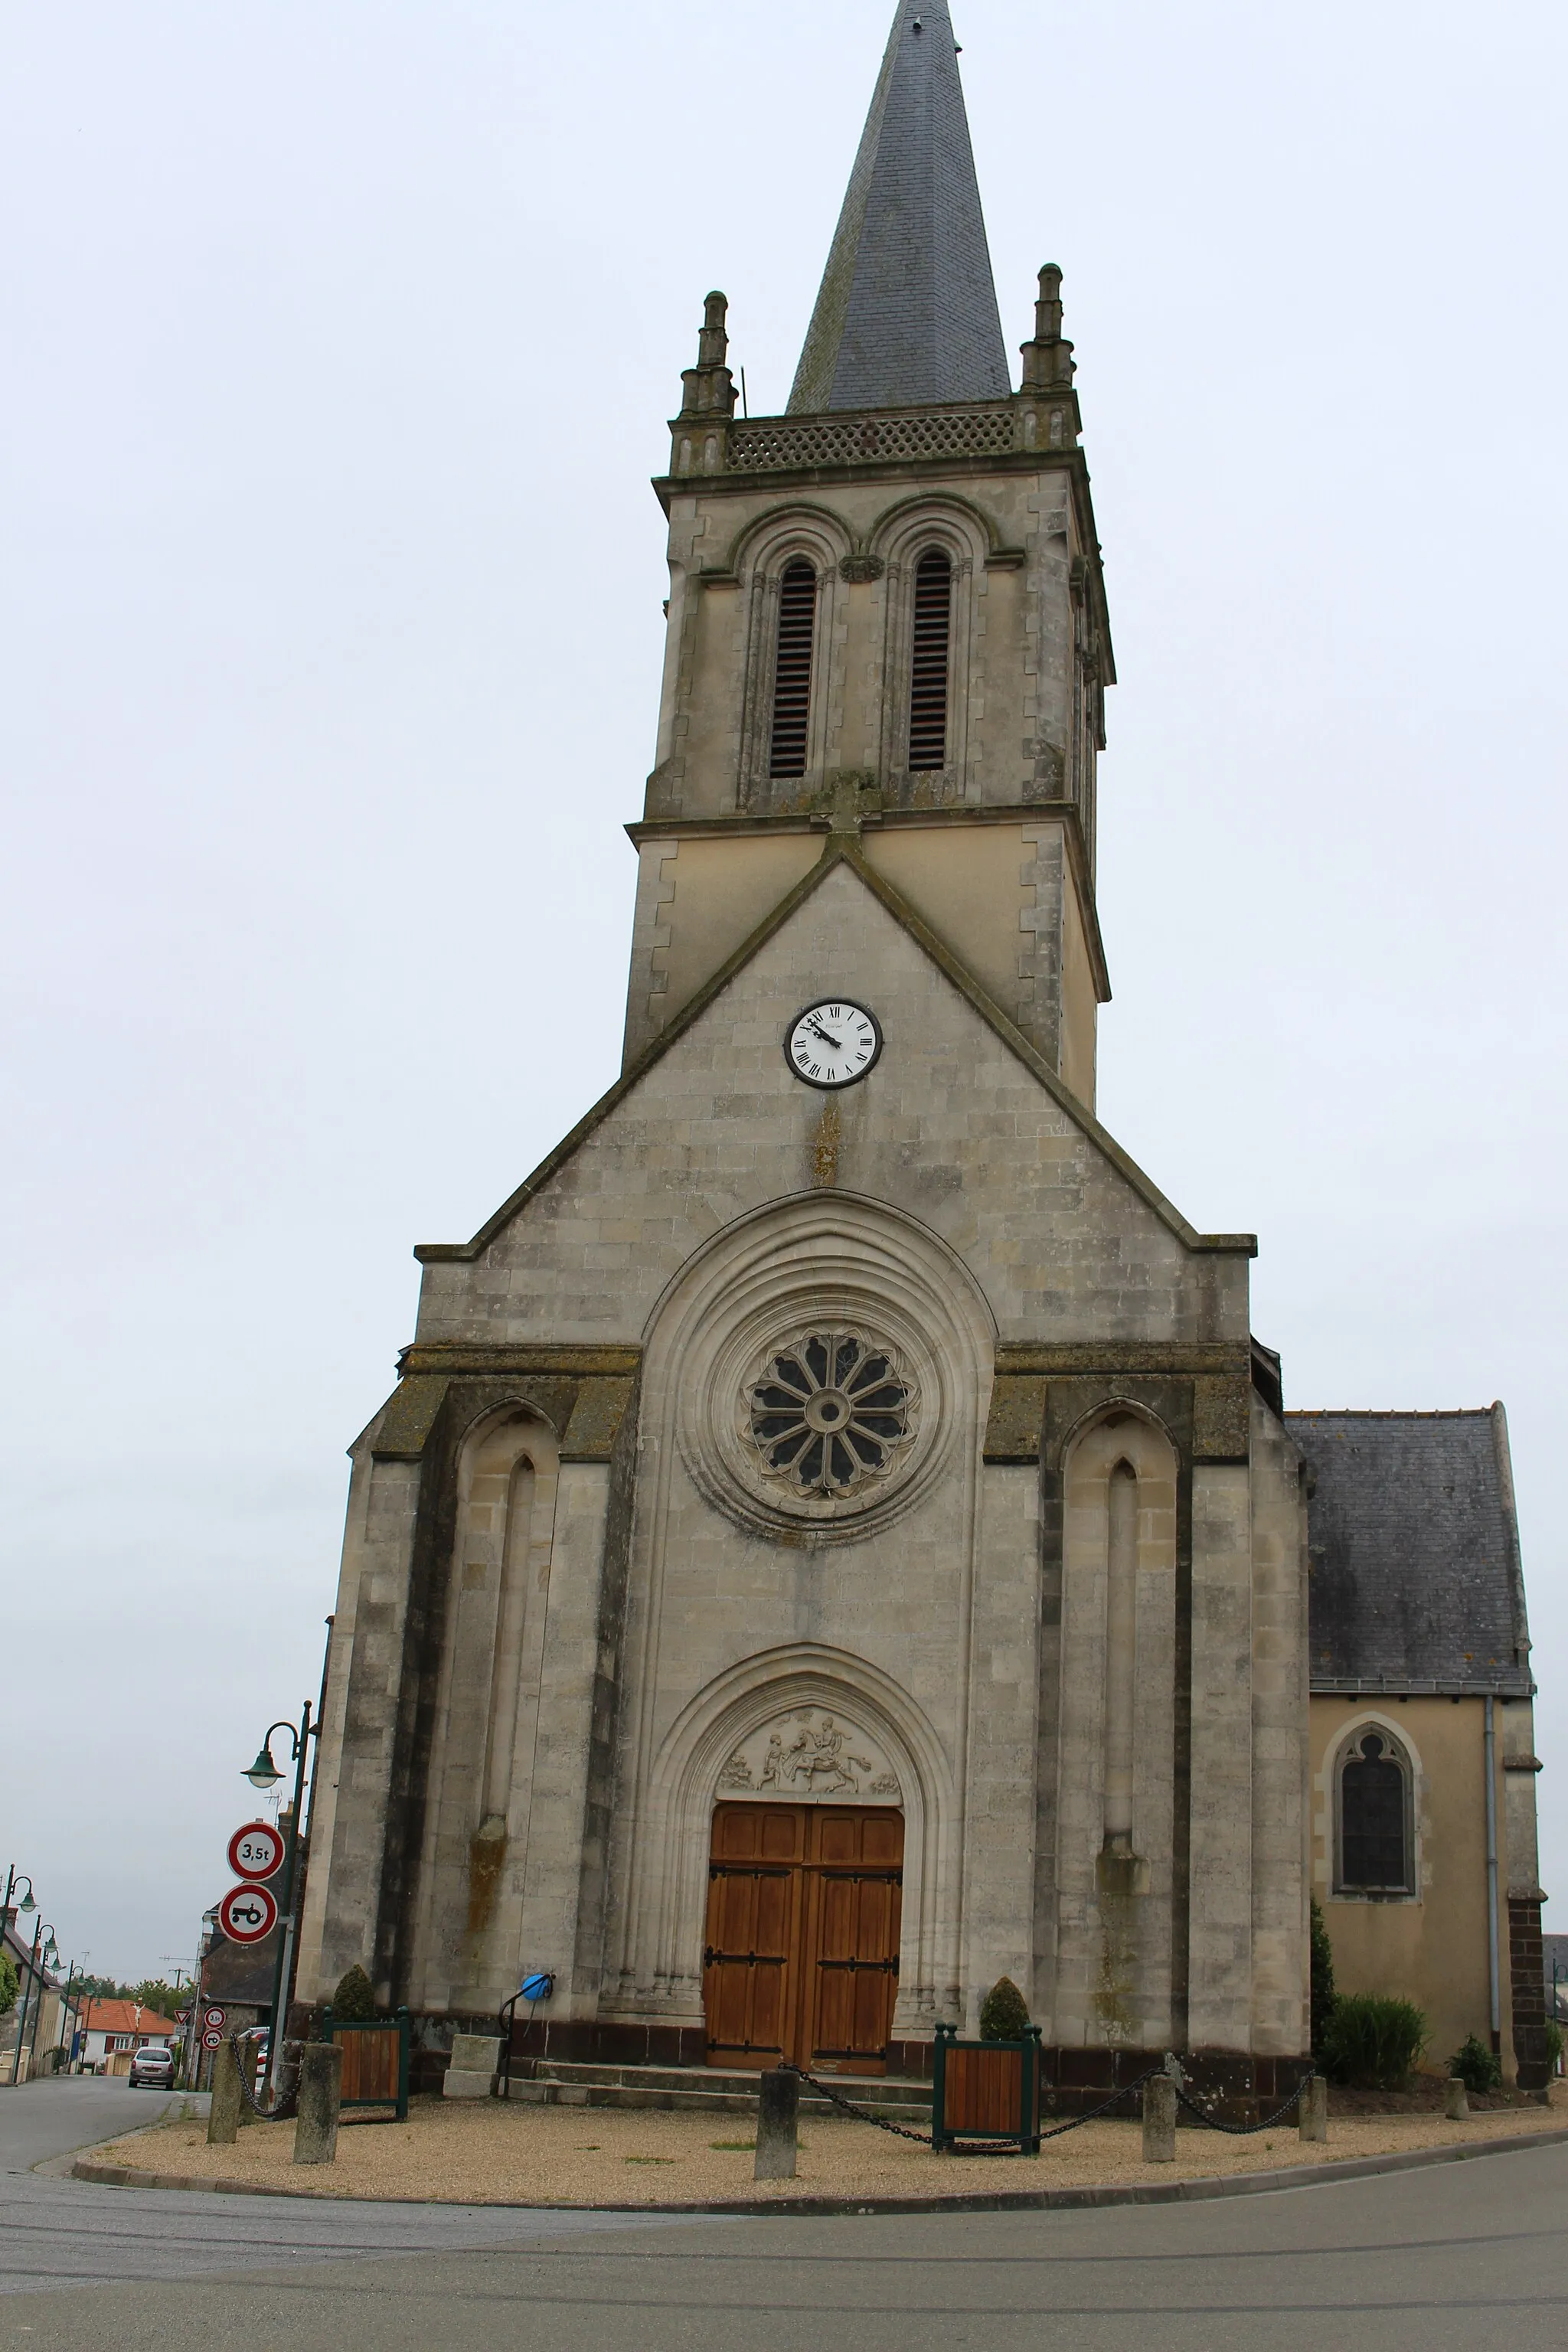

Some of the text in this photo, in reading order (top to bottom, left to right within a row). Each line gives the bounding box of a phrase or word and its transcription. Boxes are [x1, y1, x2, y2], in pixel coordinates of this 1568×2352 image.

[812, 1011, 824, 1024] XI
[829, 1006, 840, 1018] XII
[847, 1011, 855, 1021] I
[799, 1024, 812, 1033] X
[856, 1022, 869, 1031] II
[860, 1037, 873, 1046] III
[796, 1051, 812, 1068] VIII
[808, 1063, 822, 1078] VII
[827, 1067, 835, 1080] VI
[844, 1064, 853, 1075] V
[242, 1843, 270, 1861] 3,5t
